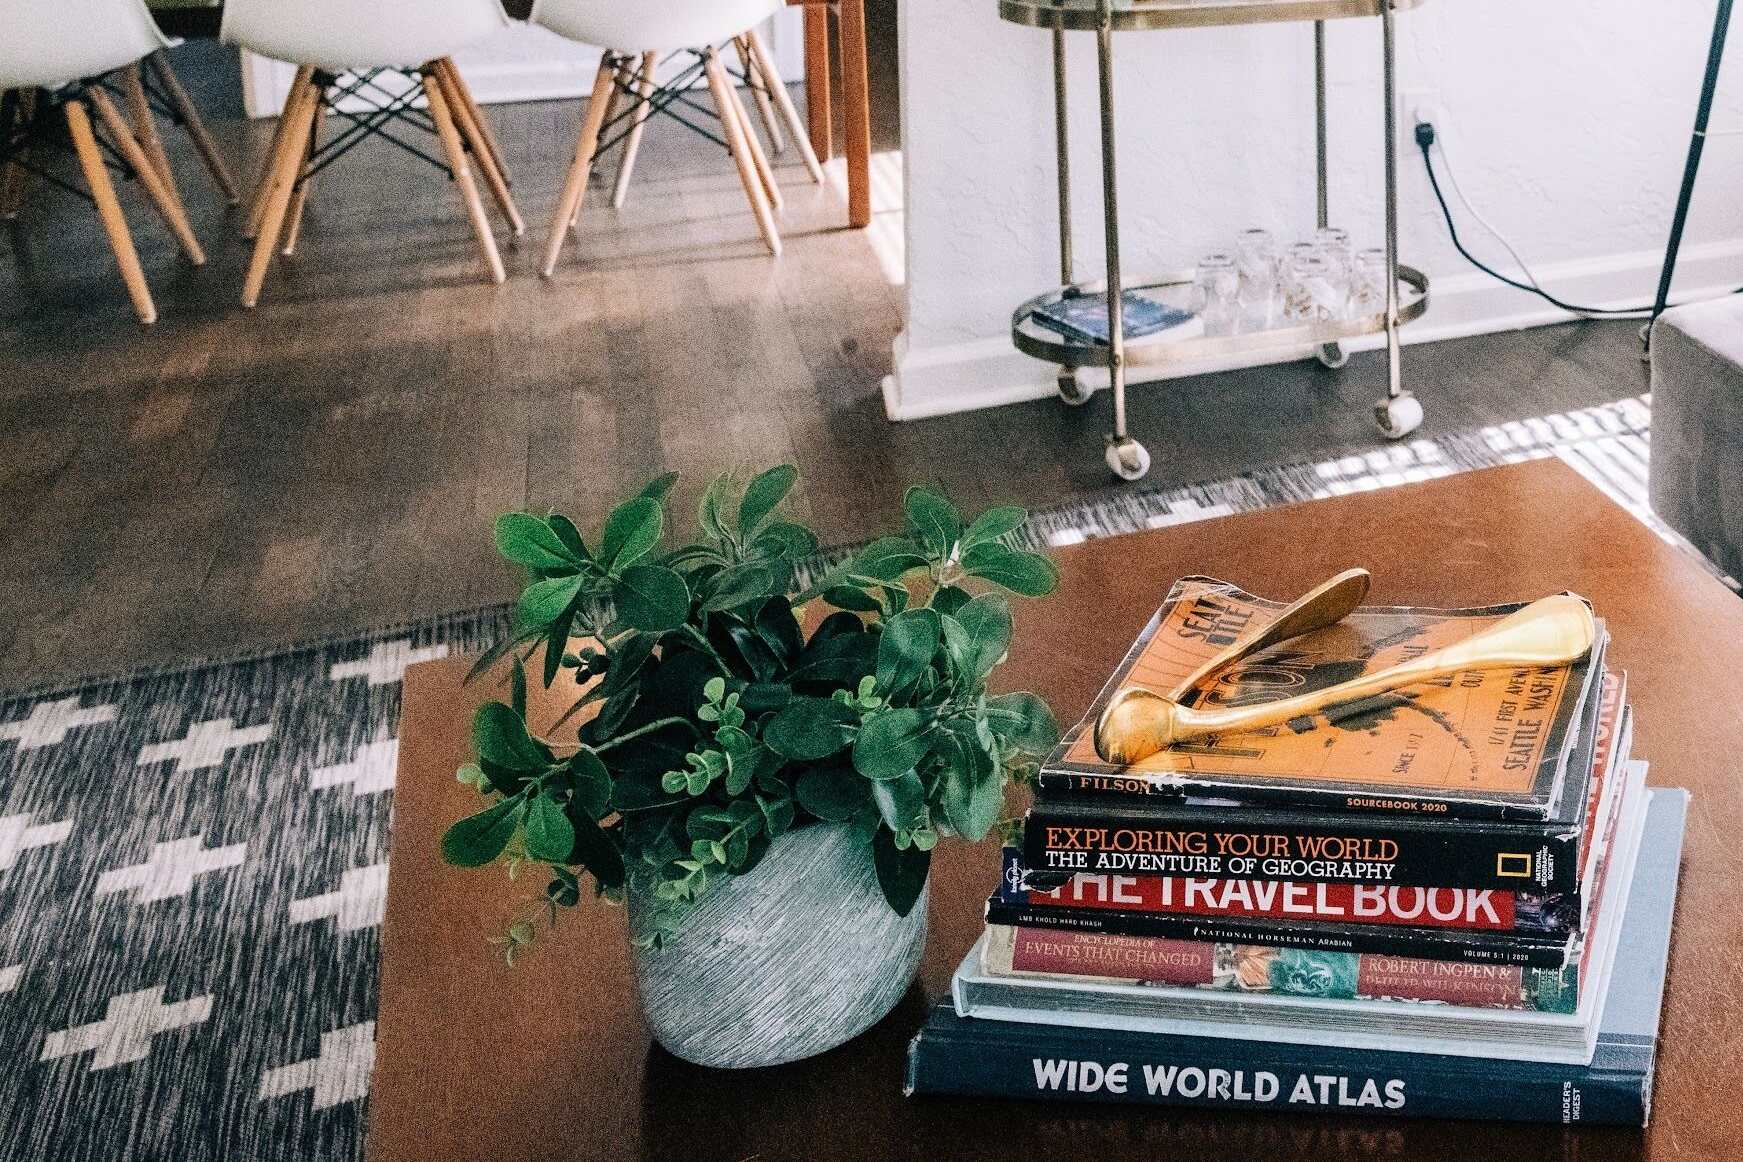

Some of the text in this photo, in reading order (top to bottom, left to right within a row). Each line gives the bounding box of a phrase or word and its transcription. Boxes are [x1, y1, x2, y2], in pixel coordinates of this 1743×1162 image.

[1495, 699, 1518, 721] FIRST
[1502, 719, 1543, 770] SEATTLE
[1392, 745, 1416, 774] SINCE
[1080, 776, 1150, 793] FILSON
[1347, 798, 1447, 813] SOURCEBOOK 2020
[1046, 827, 1399, 861] EXPLORING YOUR WORLD
[1045, 851, 1396, 880] THE ADVENTURE OF GEOGRAPHY
[1535, 850, 1543, 882] NATIONAL
[1541, 845, 1549, 887] GEOGRAPHIC
[1160, 876, 1345, 915] TRAVEL
[1353, 884, 1500, 924] BOOK
[1074, 934, 1156, 948] ENCYCLOPEDIA OF
[1201, 929, 1352, 947] NATIONAL HORSEMAN ARABIAN
[1024, 941, 1080, 957] EVENTS
[1083, 945, 1123, 960] THAT
[1126, 947, 1201, 966] CHANGED
[1463, 950, 1491, 959] VOLUME
[1368, 958, 1512, 980] ROBERT INGPEN &
[1032, 1058, 1407, 1109] WIDE WORLD ATLAS
[1573, 1088, 1581, 1120] DIGEST
